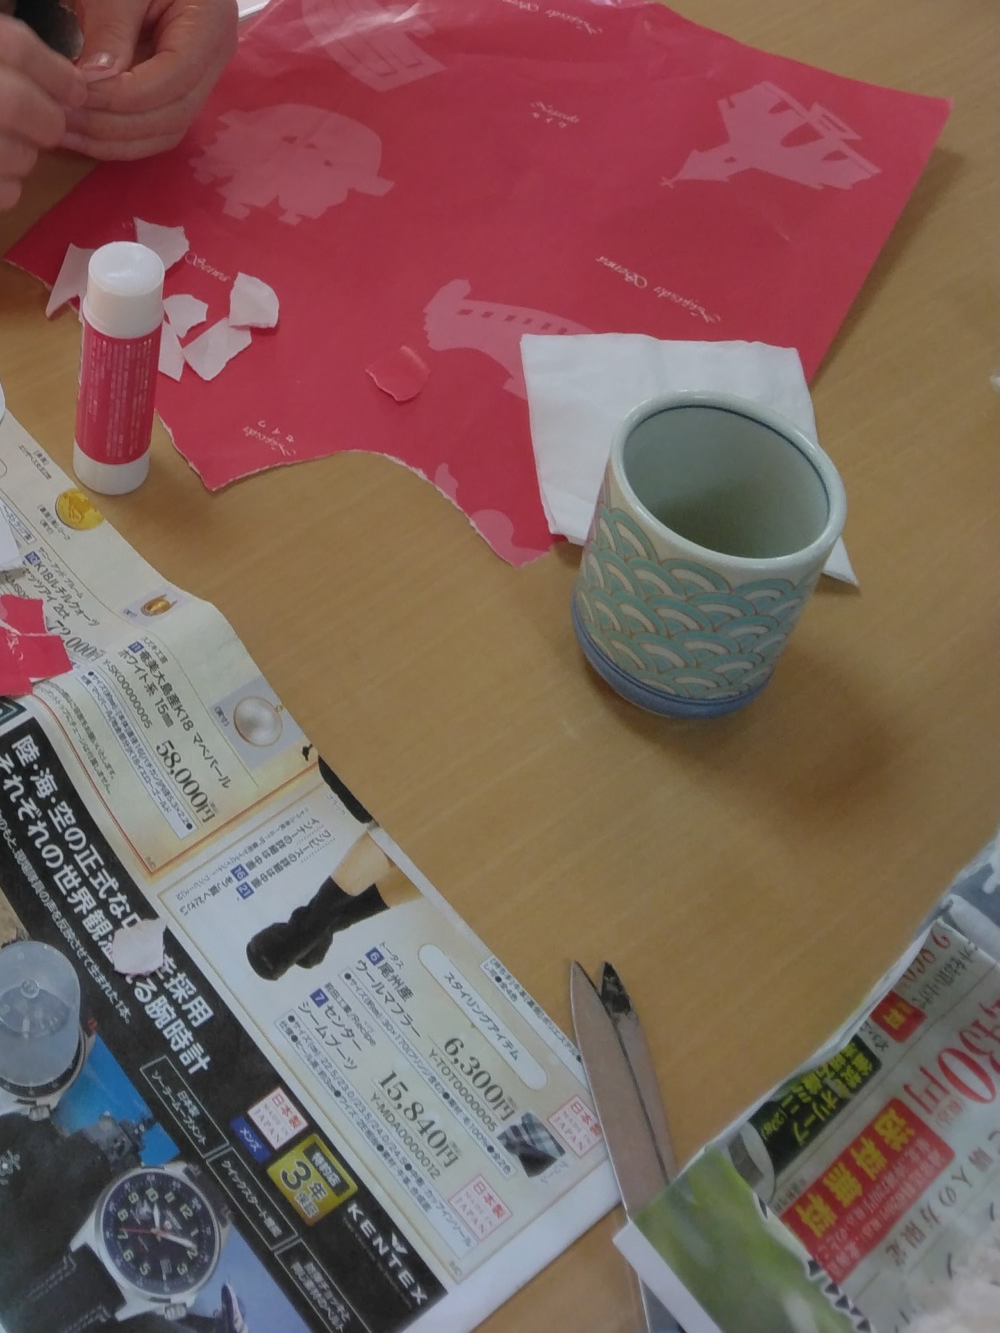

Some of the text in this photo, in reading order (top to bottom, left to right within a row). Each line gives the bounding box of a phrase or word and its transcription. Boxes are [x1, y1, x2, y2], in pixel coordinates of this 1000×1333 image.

[117, 646, 158, 697] ホワイト系
[137, 649, 195, 732] 奄美大島産K18
[153, 738, 217, 824] 58,000円
[9, 734, 215, 1028] 陸・海・空の正式なロを採用
[353, 956, 423, 1040] ウールマフラー
[376, 960, 414, 1002] 尾州産
[442, 970, 522, 1062] スタイリングアイテム
[295, 999, 357, 1073] シームブーツ
[322, 1004, 363, 1053] センター
[270, 1092, 303, 1131] 日本製
[376, 1070, 461, 1167] 15,840円
[426, 1048, 498, 1134] Y-TOT0000005
[440, 1034, 518, 1122] 6,300円
[239, 1124, 263, 1154] メンズ
[309, 1149, 341, 1187] 特約店
[367, 1091, 441, 1180] Y-MDA0000012
[791, 1105, 918, 1239] 送料無料
[345, 1202, 428, 1306] KENTEX
